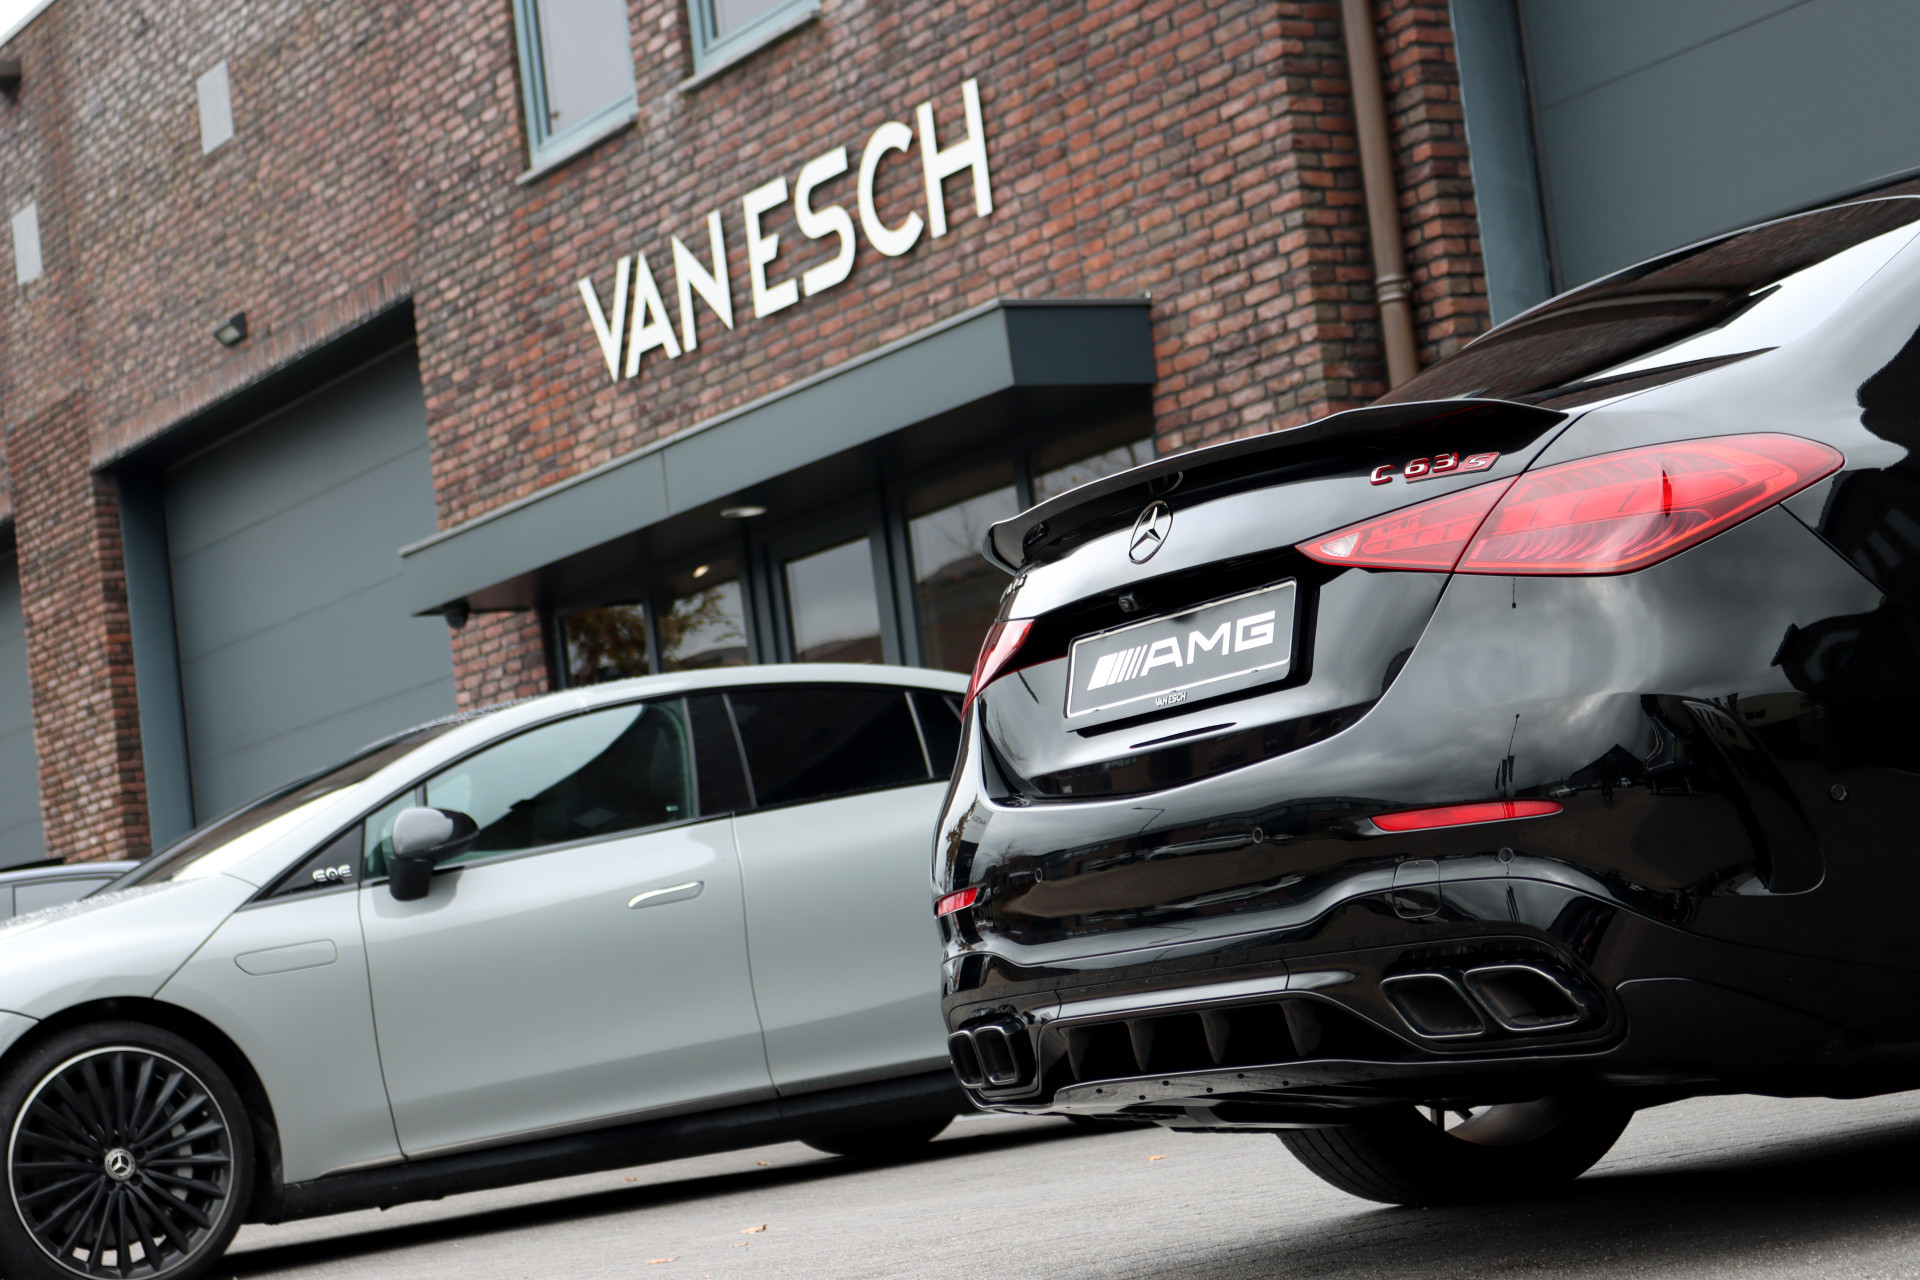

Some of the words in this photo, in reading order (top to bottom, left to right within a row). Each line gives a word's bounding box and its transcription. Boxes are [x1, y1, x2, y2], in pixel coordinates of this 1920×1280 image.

[1370, 464, 1395, 485] C
[1139, 610, 1276, 677] AMG
[312, 864, 353, 882] EQE
